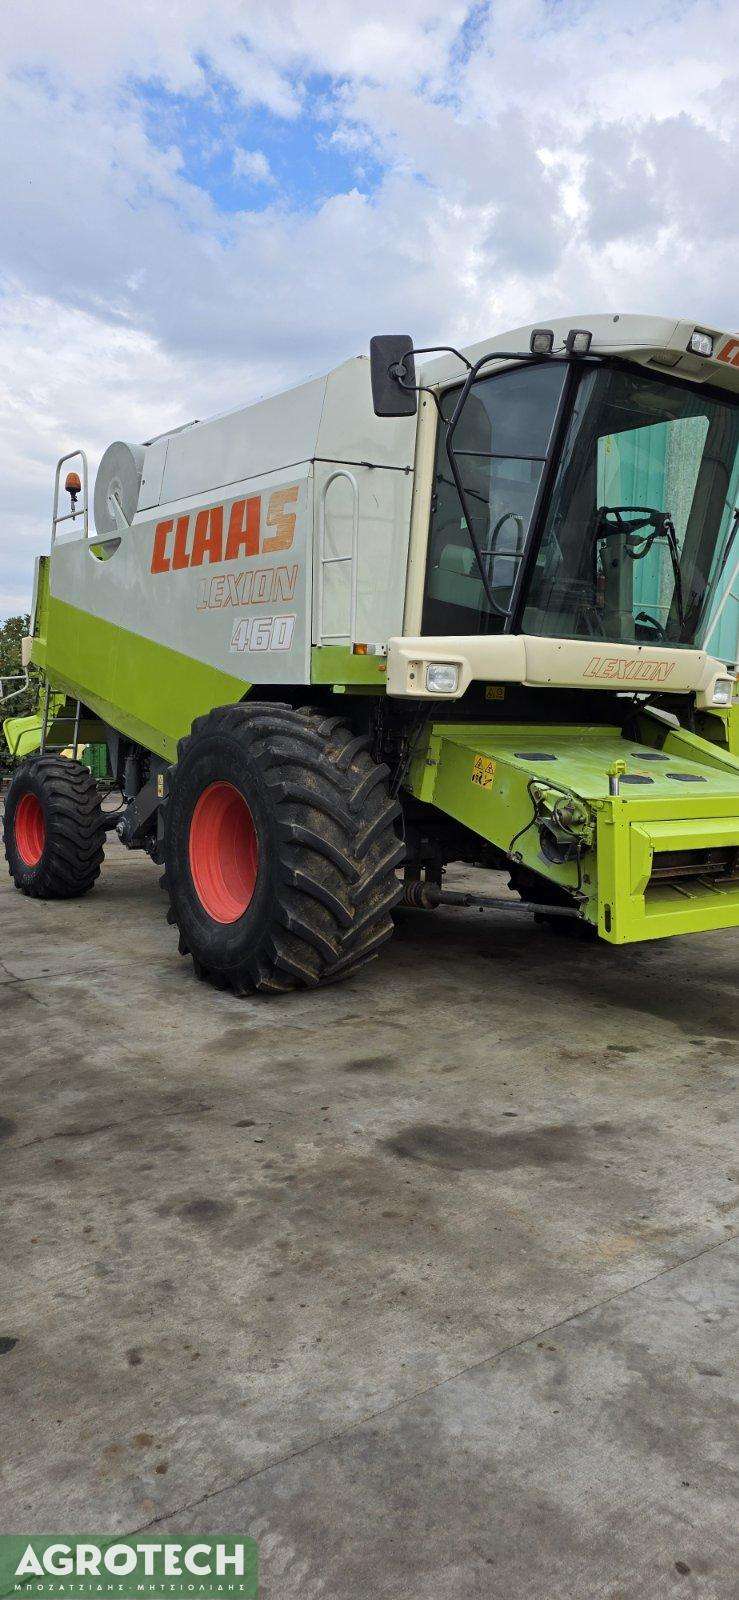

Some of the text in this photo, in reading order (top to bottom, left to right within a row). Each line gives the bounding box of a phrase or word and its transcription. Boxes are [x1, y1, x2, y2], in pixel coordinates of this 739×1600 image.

[150, 485, 300, 575] CLAAS
[196, 564, 299, 610] LEXION
[230, 615, 297, 653] 460
[583, 657, 676, 681] LEXION
